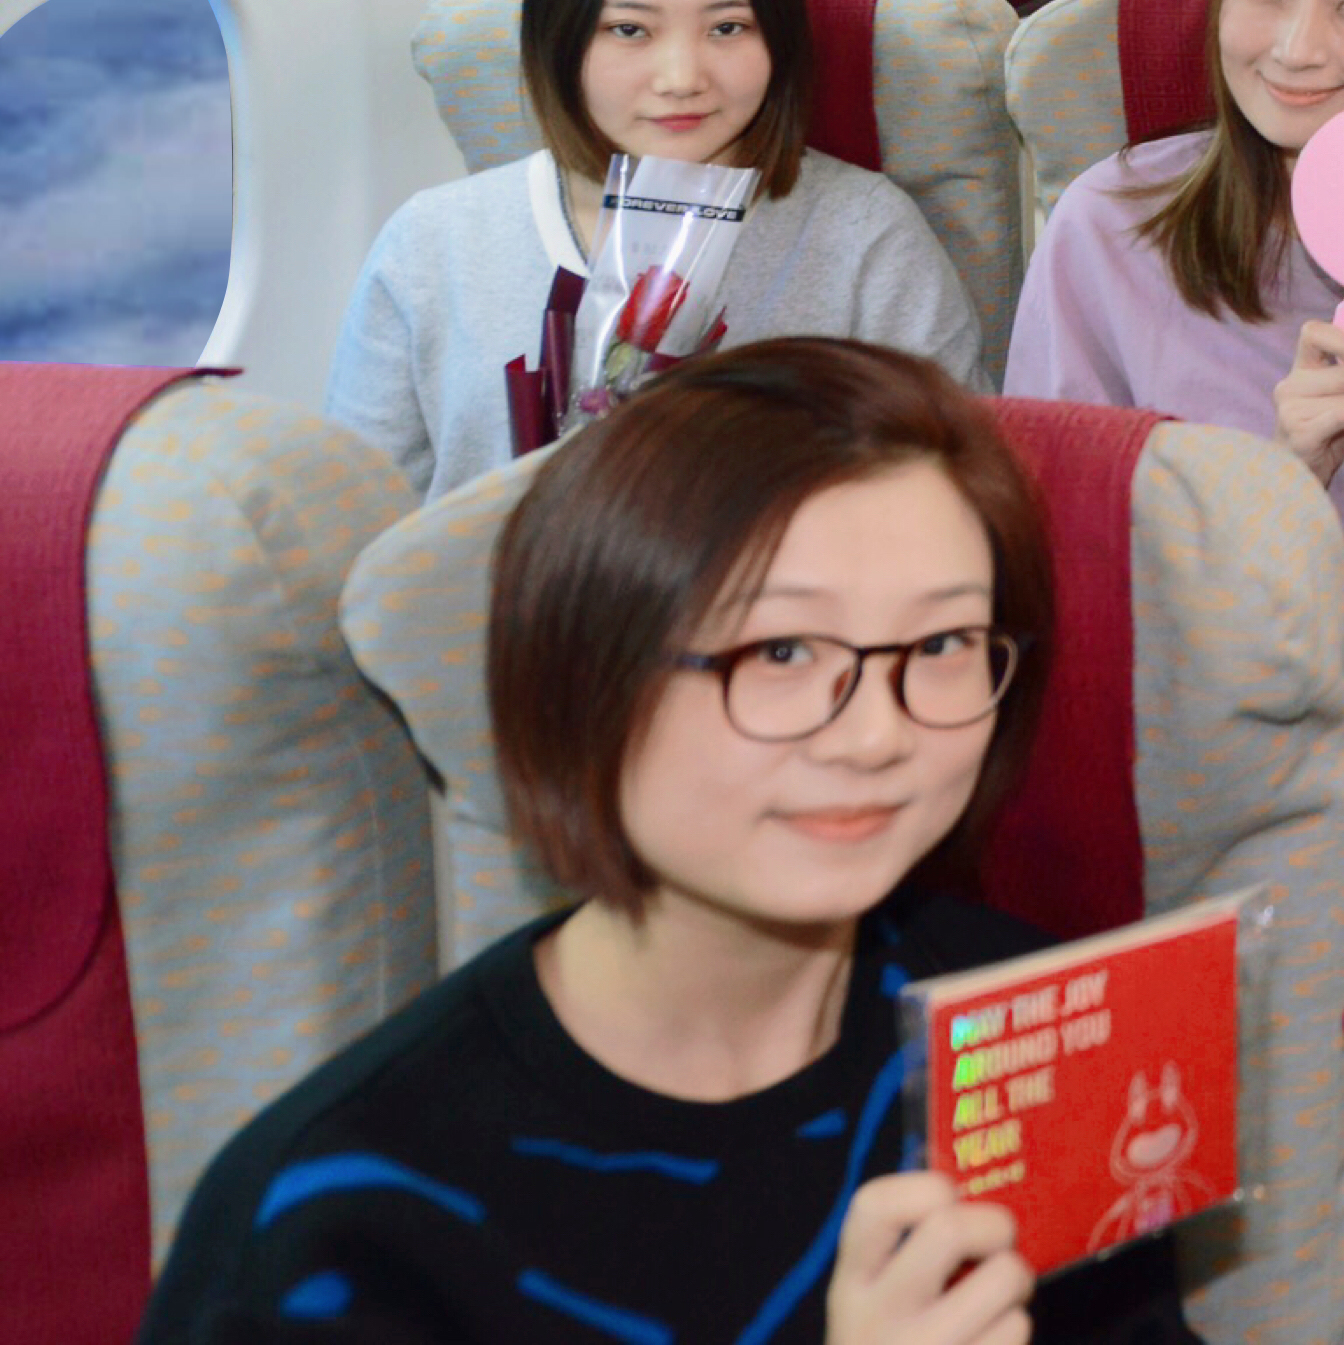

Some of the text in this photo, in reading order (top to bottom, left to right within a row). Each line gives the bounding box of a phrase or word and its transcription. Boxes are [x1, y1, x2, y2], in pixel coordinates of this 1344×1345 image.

[1059, 1008, 1112, 1057] YOU
[952, 1065, 1056, 1132] ALL THE
